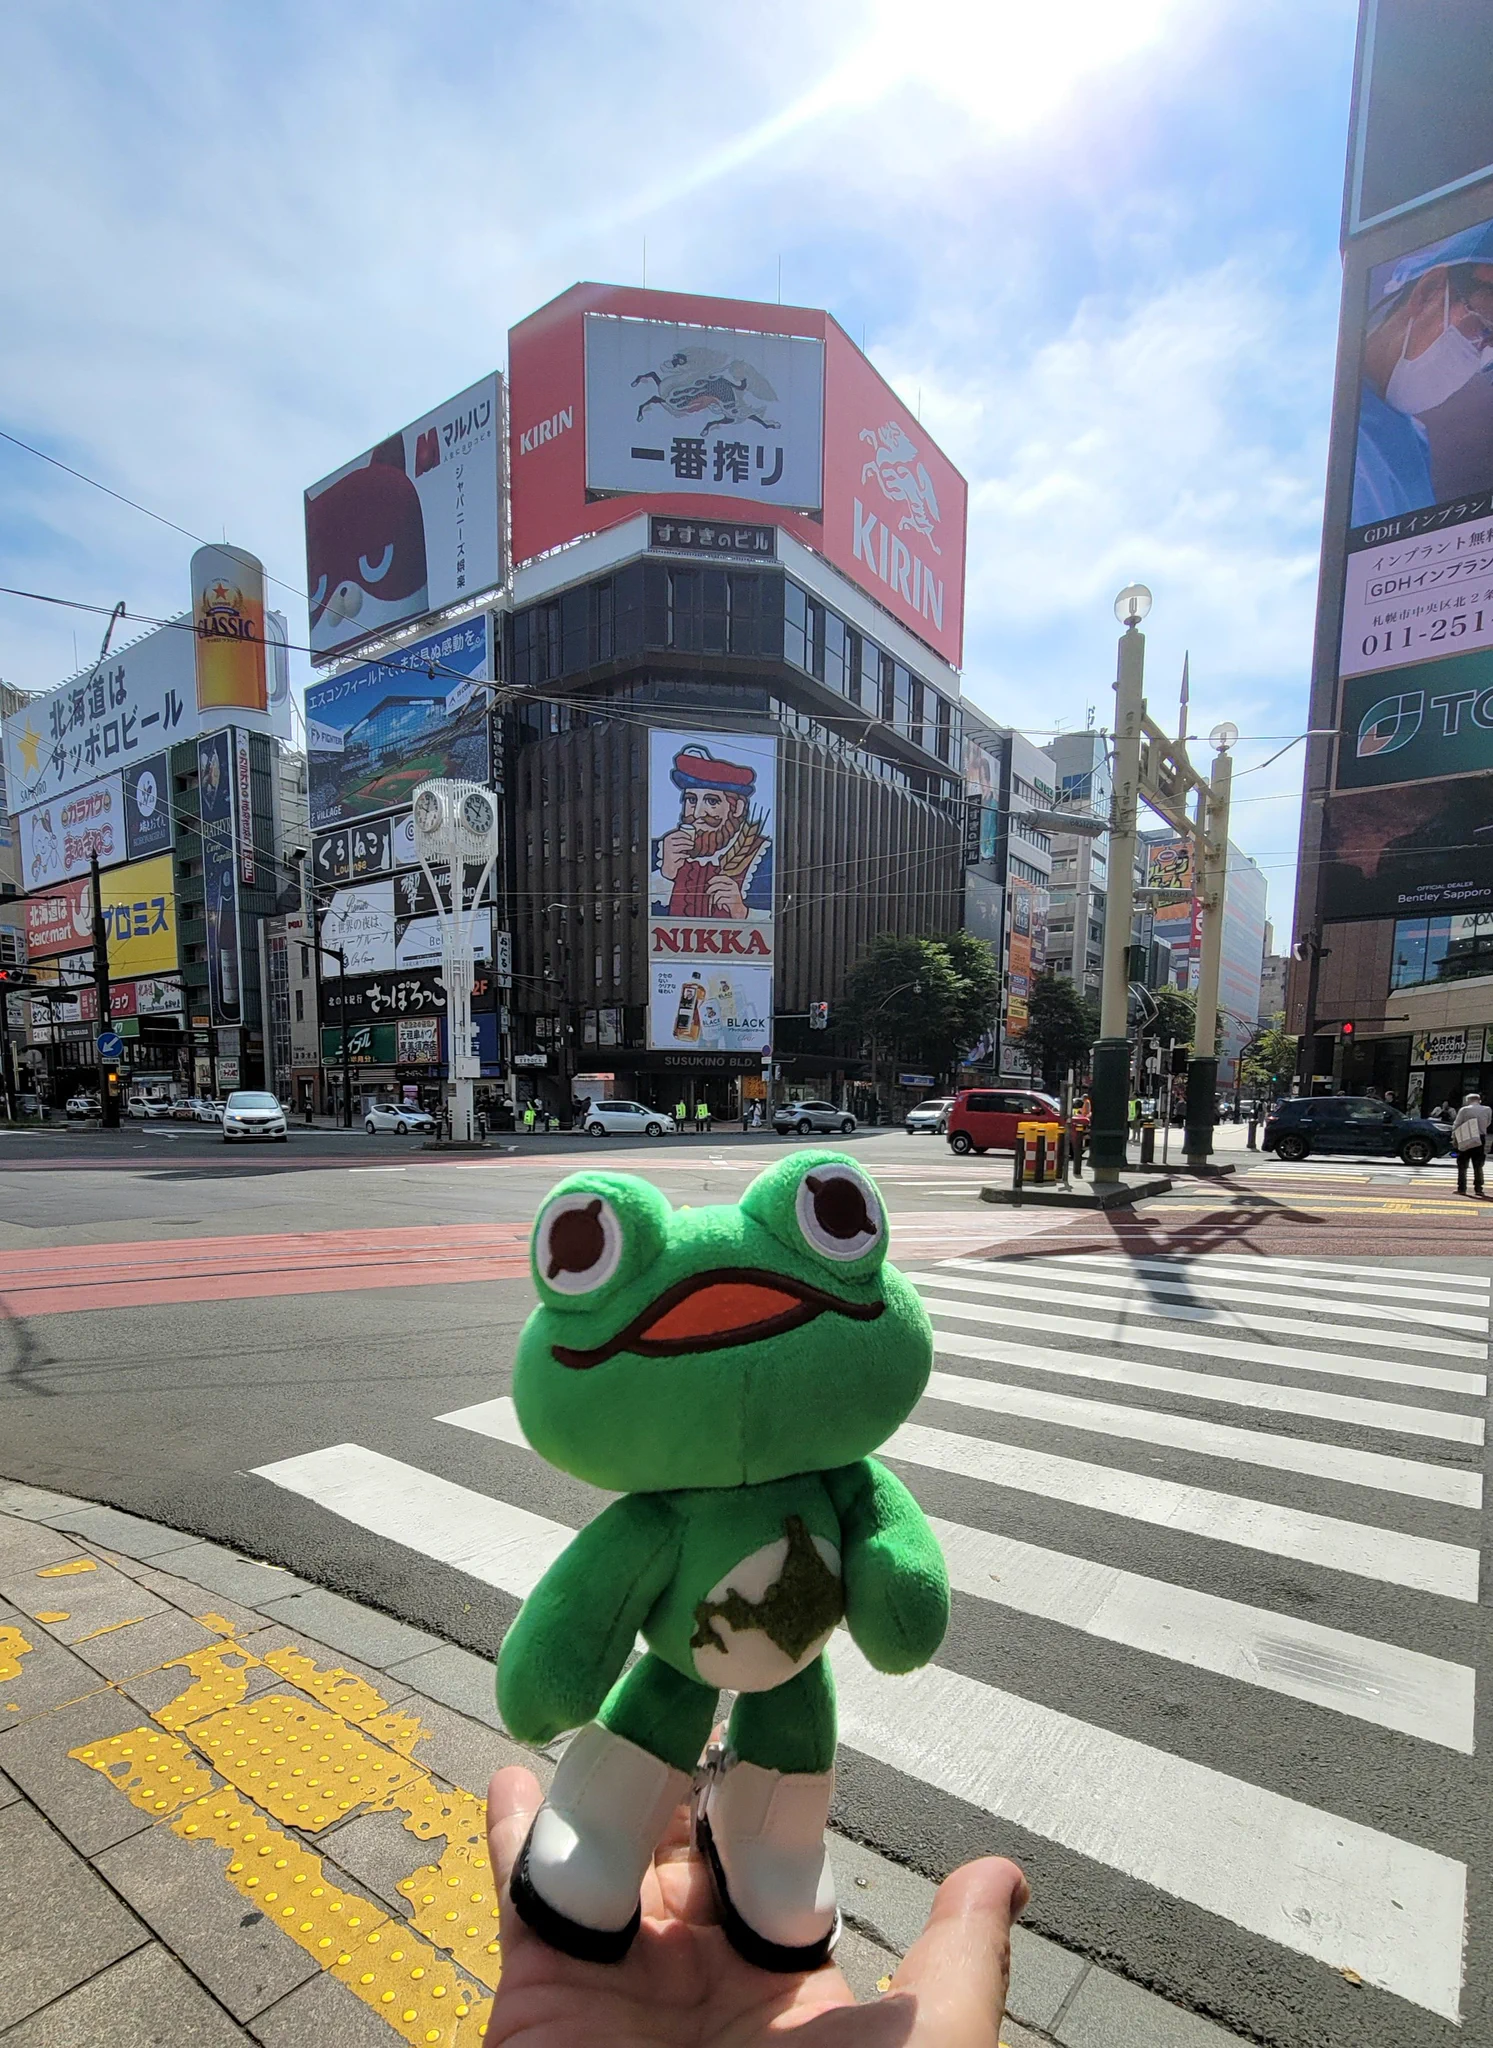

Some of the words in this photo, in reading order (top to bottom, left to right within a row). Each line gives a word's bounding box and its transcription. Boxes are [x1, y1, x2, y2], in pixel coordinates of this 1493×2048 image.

[442, 400, 491, 447] マルハン
[520, 405, 574, 456] KIRIN
[631, 437, 784, 486] 一番搾り
[455, 465, 466, 589] ジャパニーズ娯楽
[1364, 523, 1401, 543] GDH
[1406, 496, 1493, 532] インプラン
[657, 523, 769, 551] すすきのビル
[852, 496, 944, 633] KIRIN
[198, 616, 256, 639] CLASSIC
[309, 629, 482, 710] エスコンフィールドで、まだ見ぬ感動を。
[49, 665, 127, 741] 北海道は
[52, 688, 184, 783] サッポロビール
[321, 732, 343, 747] FIGHTERS
[67, 790, 105, 826] カラオケ
[311, 804, 342, 822] F.VILLAGE
[318, 831, 379, 871] くろねこ
[334, 860, 368, 876] Lounge
[1398, 892, 1440, 903] Bentley
[1443, 888, 1492, 900] Sapporo
[1416, 884, 1446, 892] OFFICIAL
[1447, 881, 1474, 889] DEALER
[30, 898, 68, 928] 北海道は
[101, 897, 170, 941] プロミス
[651, 926, 772, 955] NIKKA
[366, 976, 449, 1014] さっぽろっこ
[472, 979, 488, 996] 2F
[702, 1018, 721, 1026] BLACK
[727, 1018, 766, 1028] BLACK
[664, 1056, 725, 1067] SUSUKINO
[729, 1057, 756, 1067] BLD.
